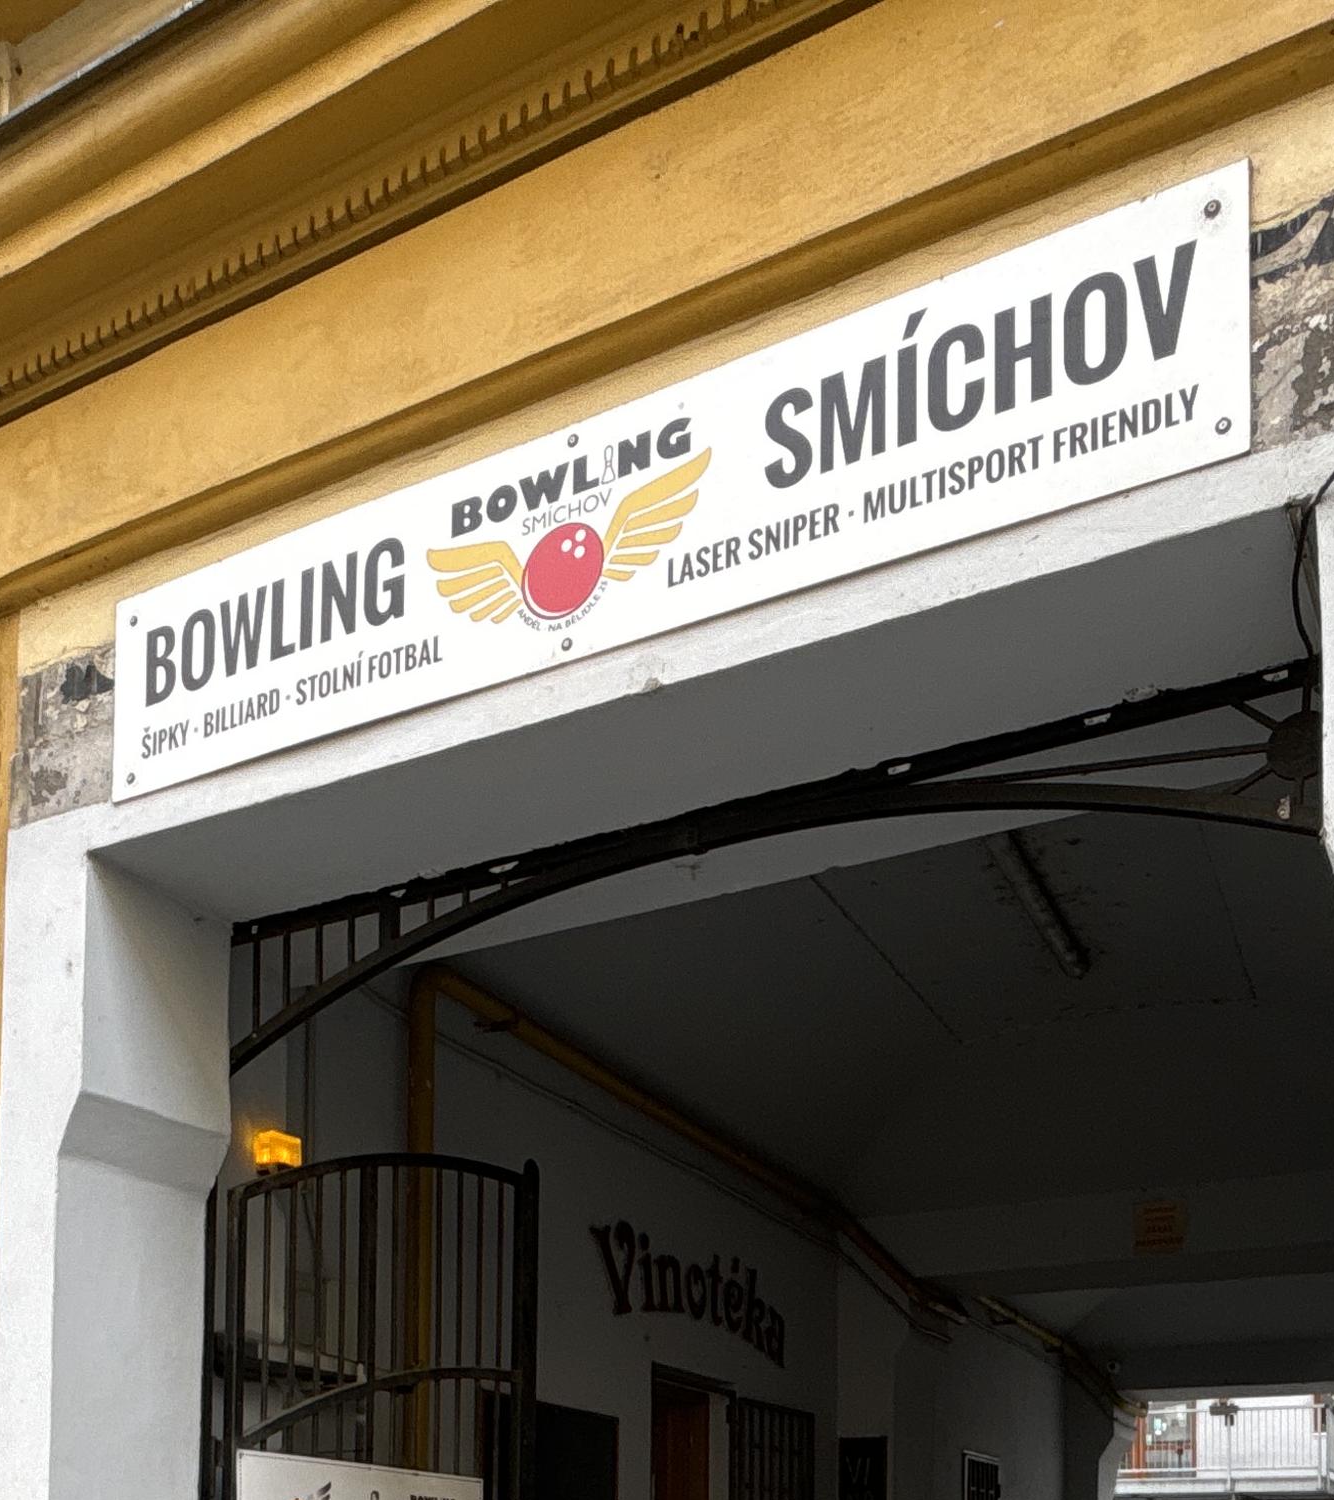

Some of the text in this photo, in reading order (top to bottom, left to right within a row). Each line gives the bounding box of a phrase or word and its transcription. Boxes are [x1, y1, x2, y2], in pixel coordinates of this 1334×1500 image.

[765, 238, 1198, 489] SMÍCHOV
[521, 488, 613, 537] SMÍCHOV
[667, 383, 1199, 588] LASER SNIPER MULTISPORT FRIENDLY
[141, 634, 443, 760] ŠIPKY BILLIARD STOLNÍ FOTBAL
[145, 537, 405, 708] BOWLING
[588, 1220, 785, 1368] Vinotéka
